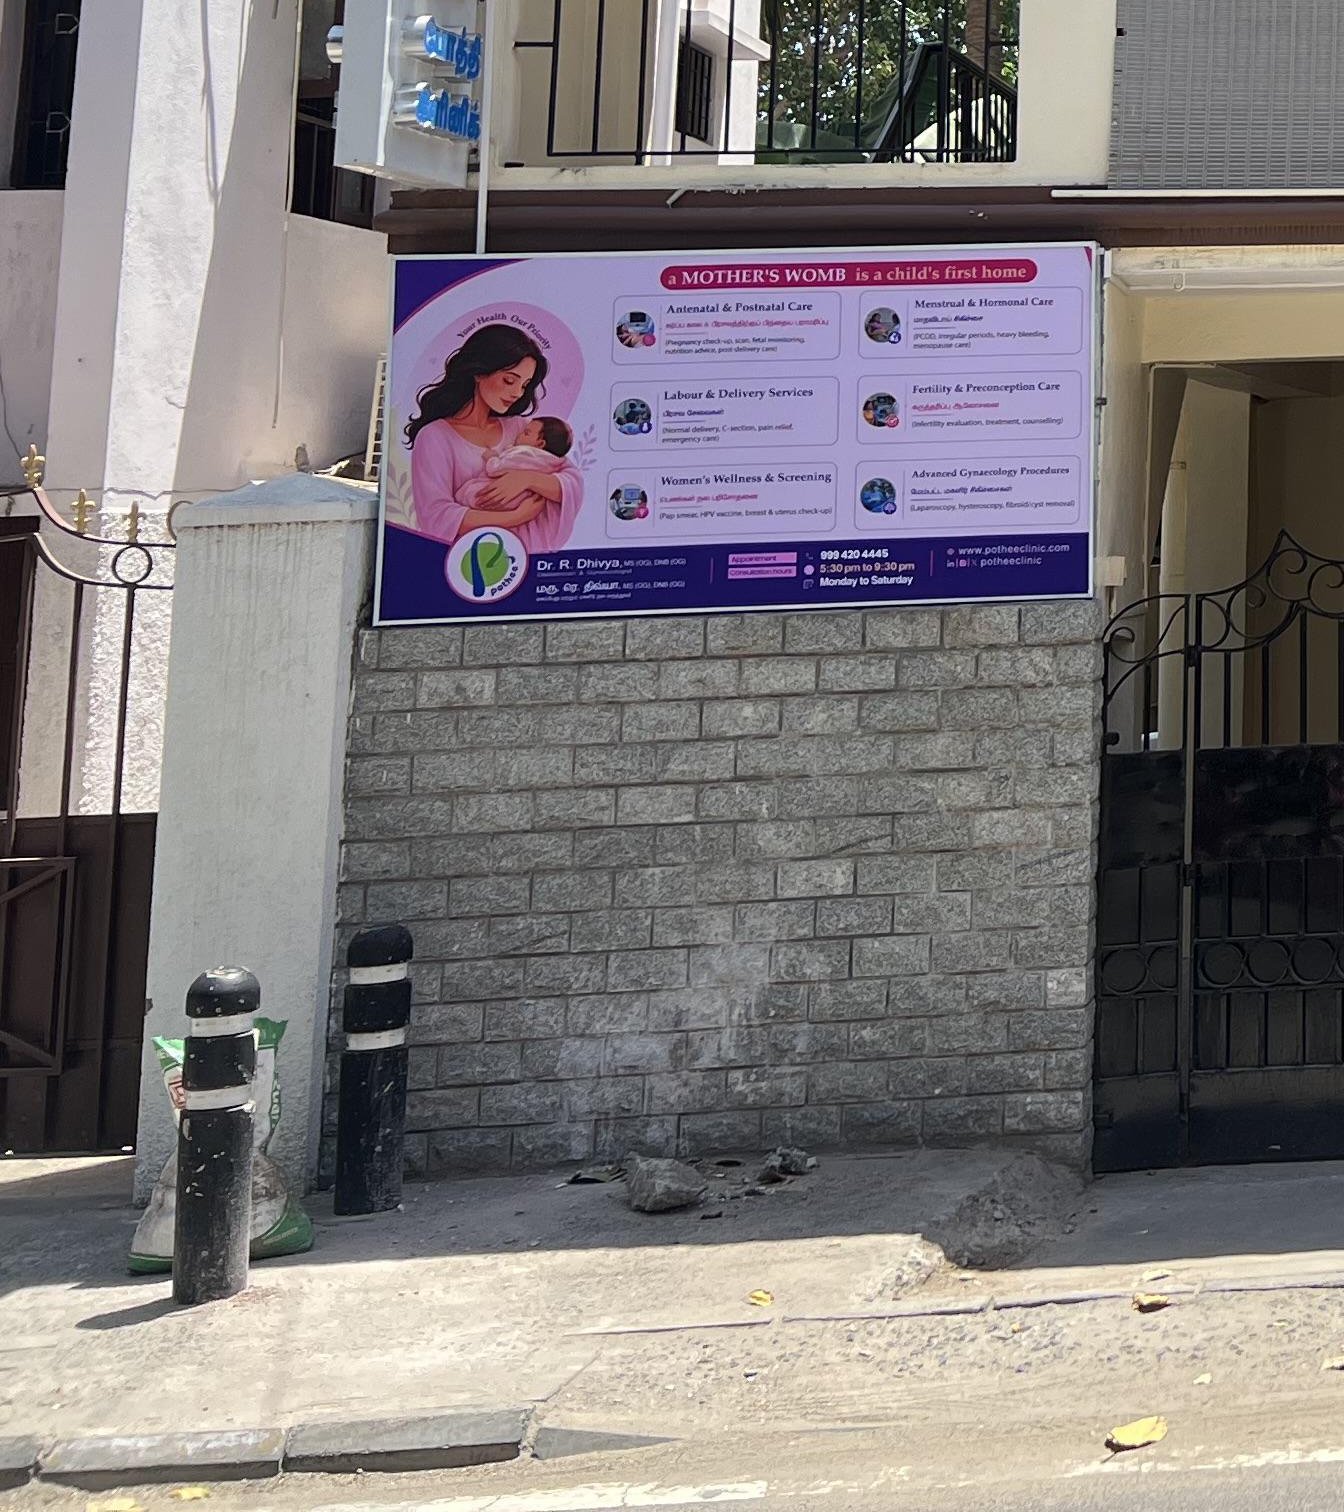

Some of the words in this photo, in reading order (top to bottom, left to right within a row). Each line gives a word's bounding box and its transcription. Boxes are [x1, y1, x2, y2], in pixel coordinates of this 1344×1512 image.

[668, 274, 677, 285] a
[682, 269, 780, 286] MOTHER'S
[784, 268, 847, 283] WOMB
[855, 267, 869, 281] is
[873, 270, 882, 281] a
[887, 266, 940, 281] child's
[944, 265, 977, 280] first
[981, 265, 1027, 279] home
[667, 304, 720, 314] Antenatal
[722, 303, 732, 313] &
[735, 302, 785, 312] Postnatal
[788, 302, 813, 311] Care
[915, 299, 965, 309] Menstrual
[968, 299, 977, 308] &
[979, 298, 1029, 307] Hormonal
[1031, 297, 1054, 307] Care
[457, 321, 476, 338] Your
[476, 313, 507, 325] Health
[510, 314, 528, 327] Our
[527, 323, 552, 350] Priority
[664, 389, 702, 400] Labour
[706, 389, 715, 399] &
[718, 388, 765, 400] Delivery
[769, 387, 813, 397] Services
[912, 384, 952, 395] Fertility
[955, 384, 964, 393] &
[966, 382, 1035, 394] Preconception
[1038, 382, 1061, 391] Care
[714, 474, 762, 484] Wellness
[765, 473, 774, 483] &
[778, 472, 832, 484] Screening
[912, 469, 957, 478] Advanced
[959, 467, 1018, 479] Gynaecology
[1020, 466, 1070, 476] Procedures
[820, 550, 840, 560] 999
[841, 549, 861, 559] 420
[861, 549, 889, 558] 4445
[958, 543, 1070, 555] www.potheeclinic.com
[537, 560, 556, 571] Dr.
[577, 558, 623, 570] Dhivya,
[731, 555, 777, 563] Appointment
[980, 556, 1043, 568] potheeclinic
[819, 564, 843, 573] 5:30
[844, 564, 861, 574] pm
[862, 563, 873, 571] to
[874, 562, 898, 571] 9:30
[898, 562, 915, 572] pm
[819, 577, 858, 587] Monday
[859, 576, 869, 585] to
[871, 575, 914, 586] Saturday
